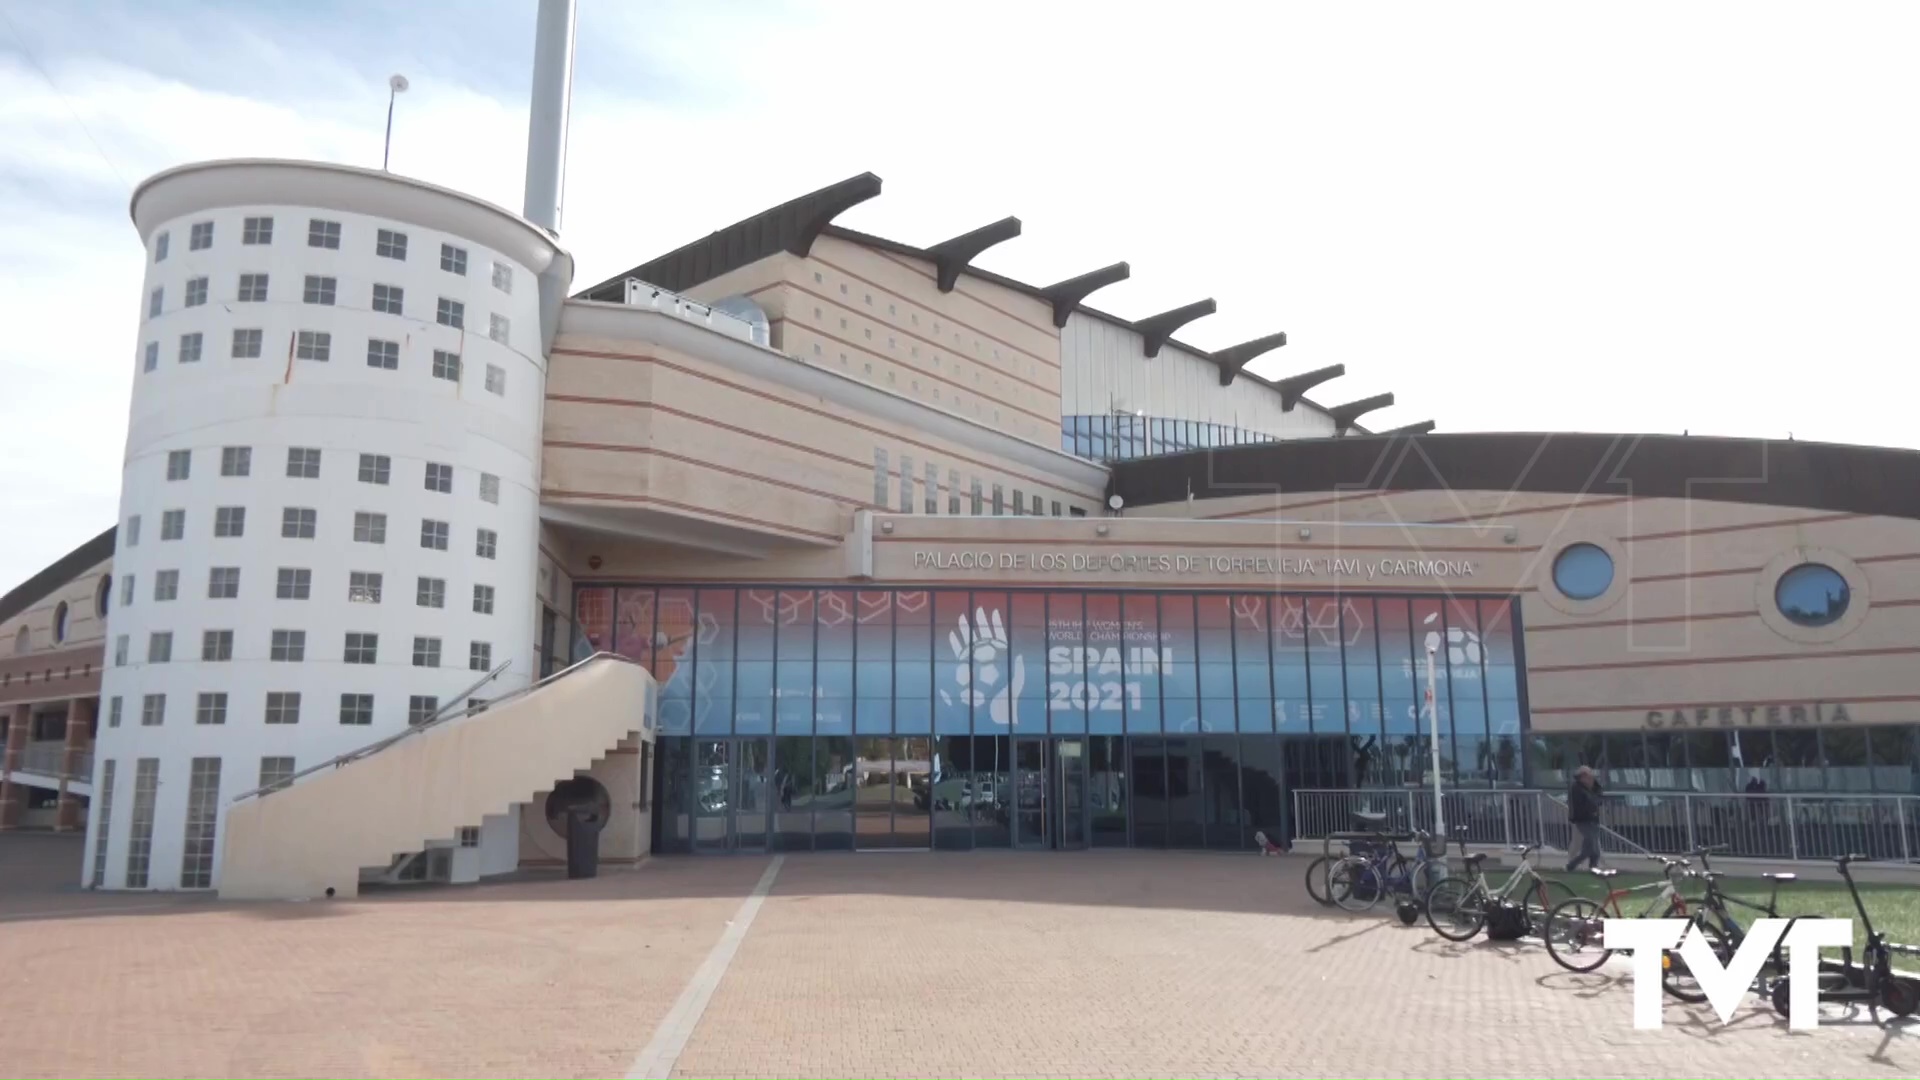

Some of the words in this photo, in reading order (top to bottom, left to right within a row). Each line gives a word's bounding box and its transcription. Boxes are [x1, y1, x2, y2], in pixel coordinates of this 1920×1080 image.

[914, 551, 993, 569] PALACIO
[1001, 553, 1025, 570] DE
[1031, 553, 1067, 571] LOS
[1073, 554, 1171, 572] DEPORTES
[1176, 555, 1201, 572] DE
[1366, 563, 1376, 580] y
[1046, 646, 1173, 675] SPAIN
[1046, 681, 1142, 711] 2021
